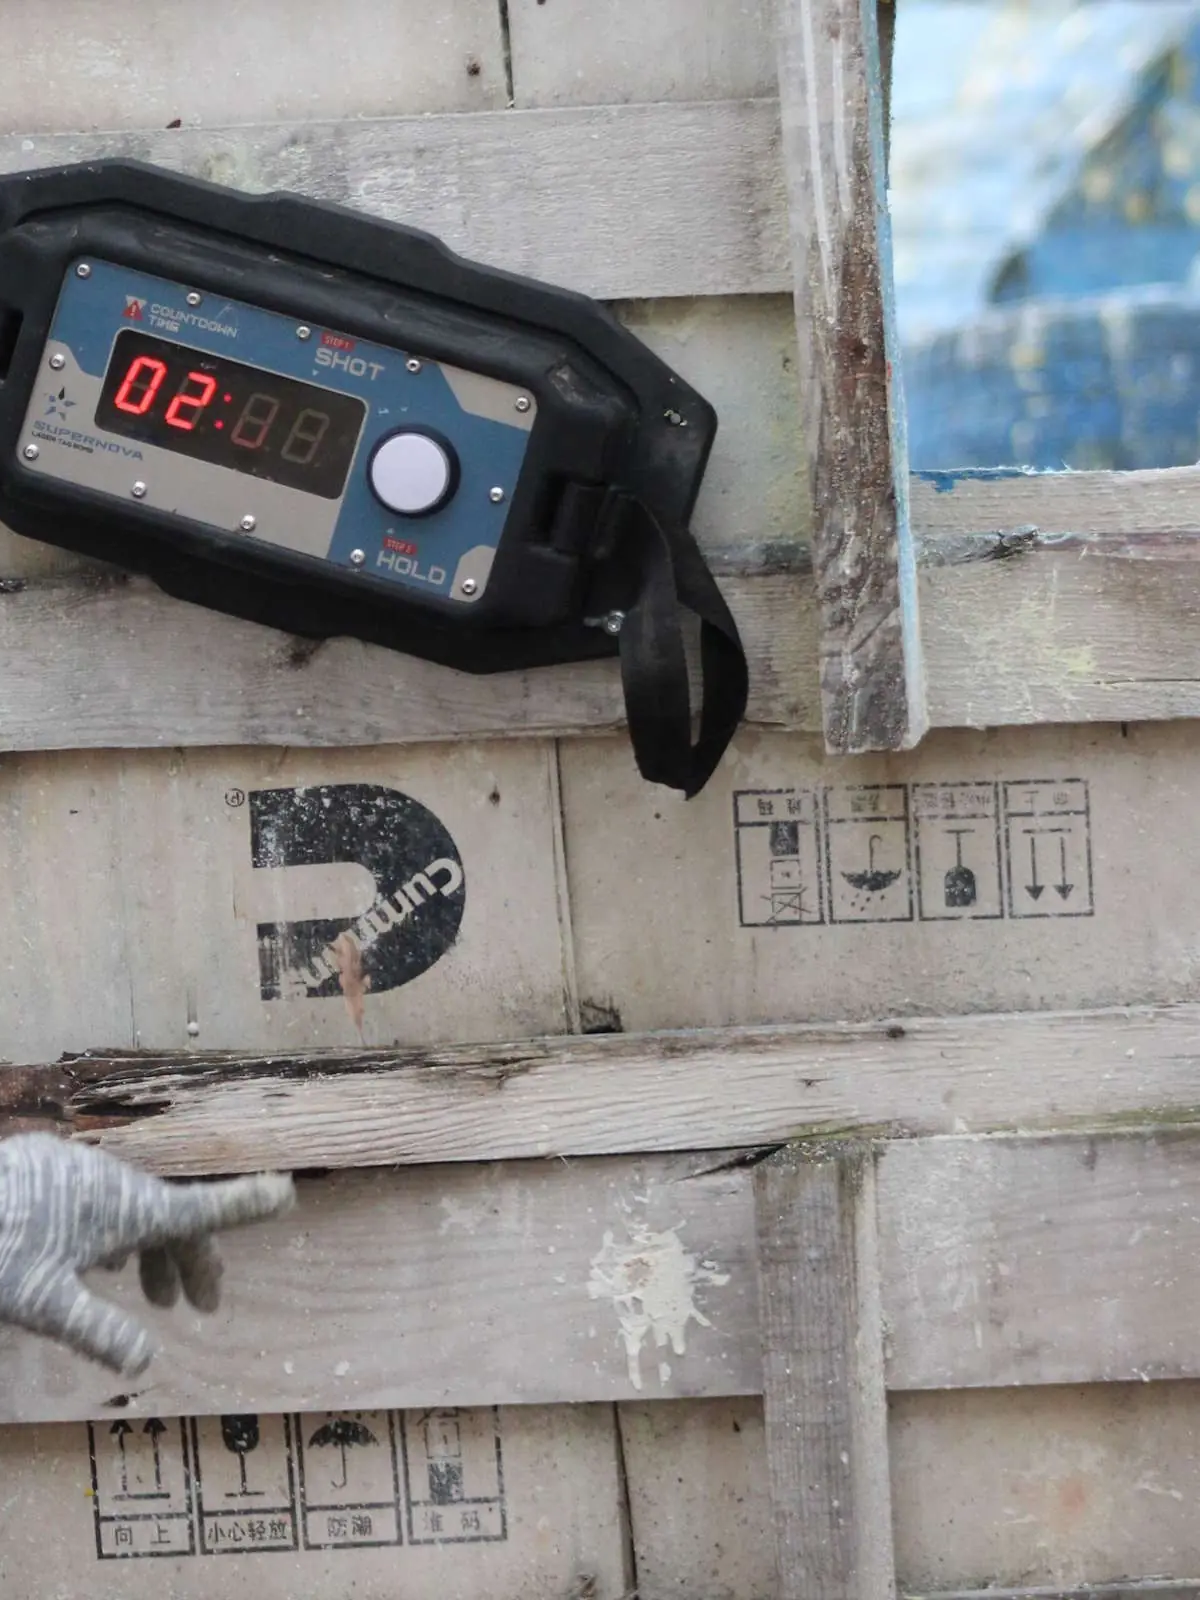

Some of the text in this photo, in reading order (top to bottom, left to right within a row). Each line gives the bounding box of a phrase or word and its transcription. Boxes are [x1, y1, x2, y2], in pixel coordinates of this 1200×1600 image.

[151, 303, 238, 338] COUNTDOWN
[314, 347, 386, 381] SHOT
[32, 420, 143, 461] SUPERNOVA
[376, 550, 446, 585] HOLD
[280, 857, 463, 1000] Cummin
[114, 1523, 171, 1546] 向上
[207, 1519, 288, 1543] 小心轻放
